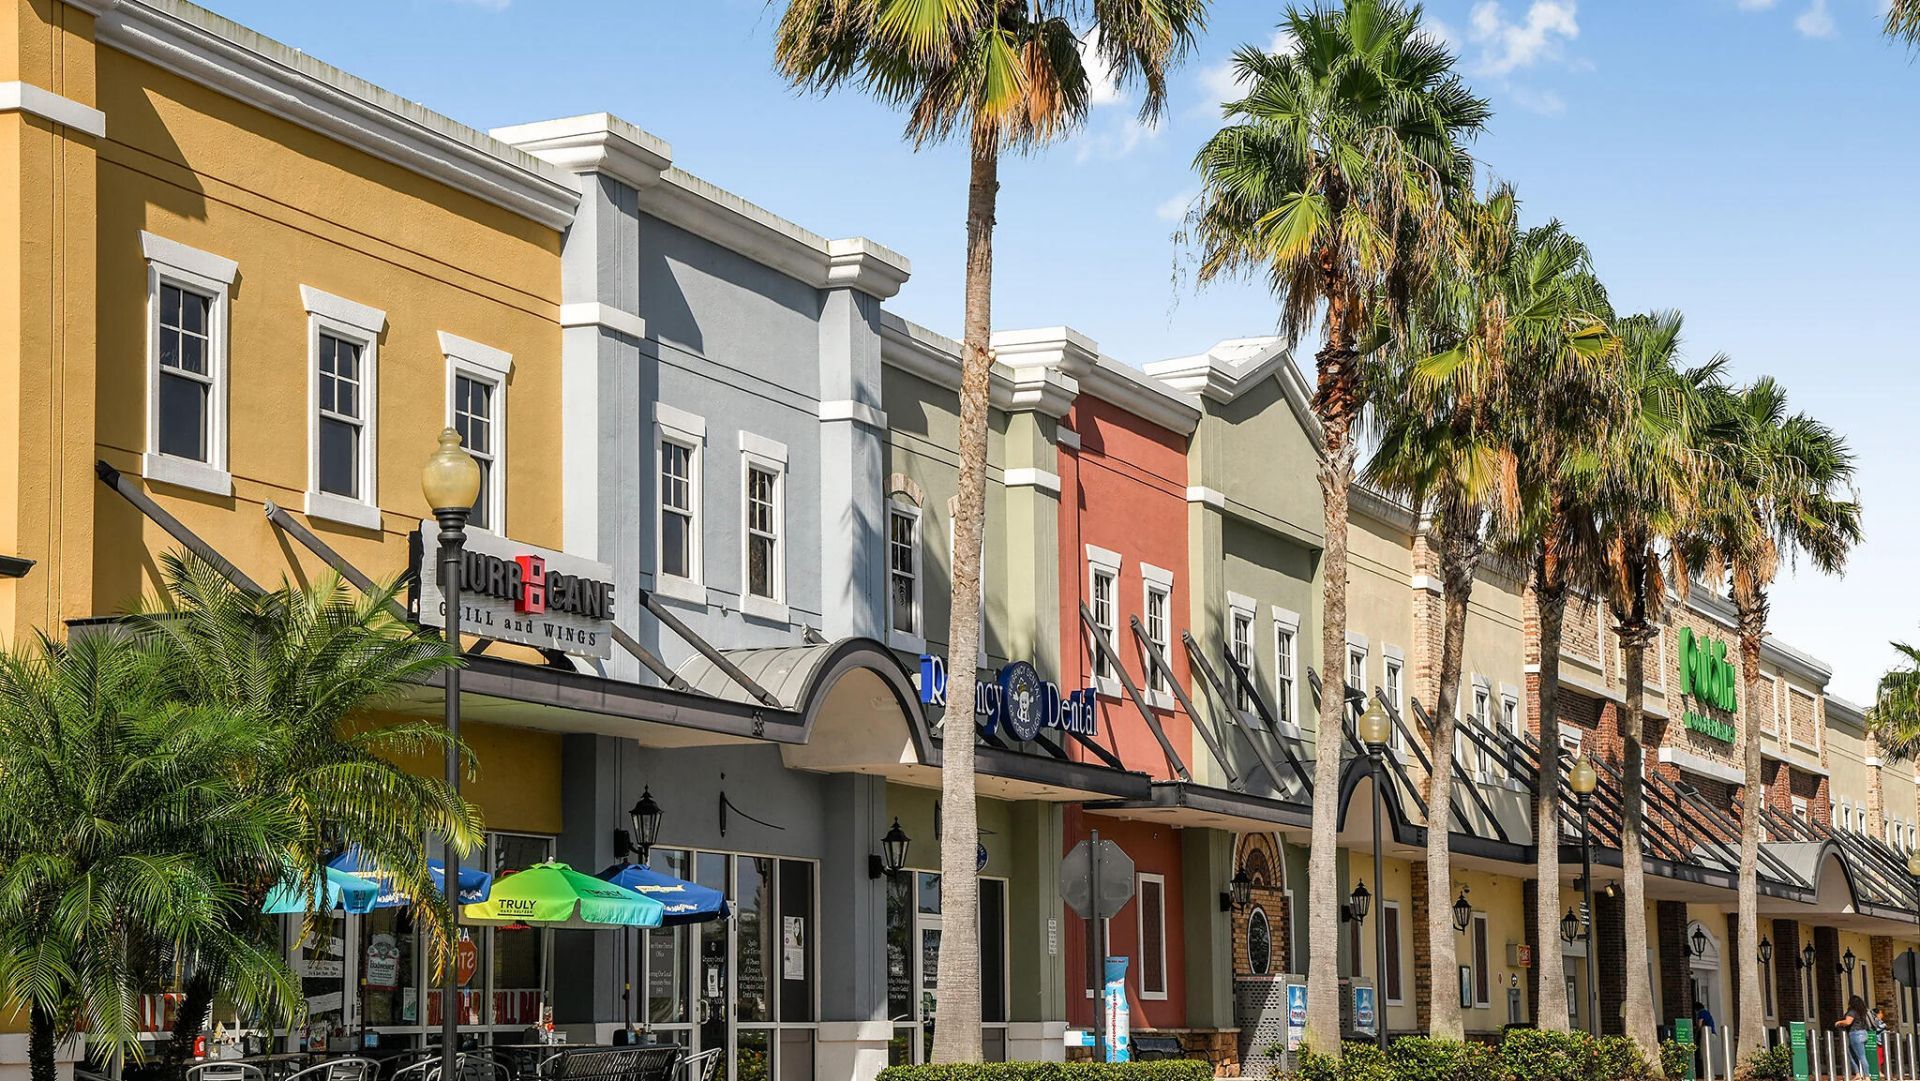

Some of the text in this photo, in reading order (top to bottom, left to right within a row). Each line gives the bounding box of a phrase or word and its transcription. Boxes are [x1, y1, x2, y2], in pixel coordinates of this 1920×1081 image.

[439, 601, 596, 646] GILL and WINGS
[929, 655, 1098, 736] Rncy Dental
[498, 899, 537, 910] TRULY
